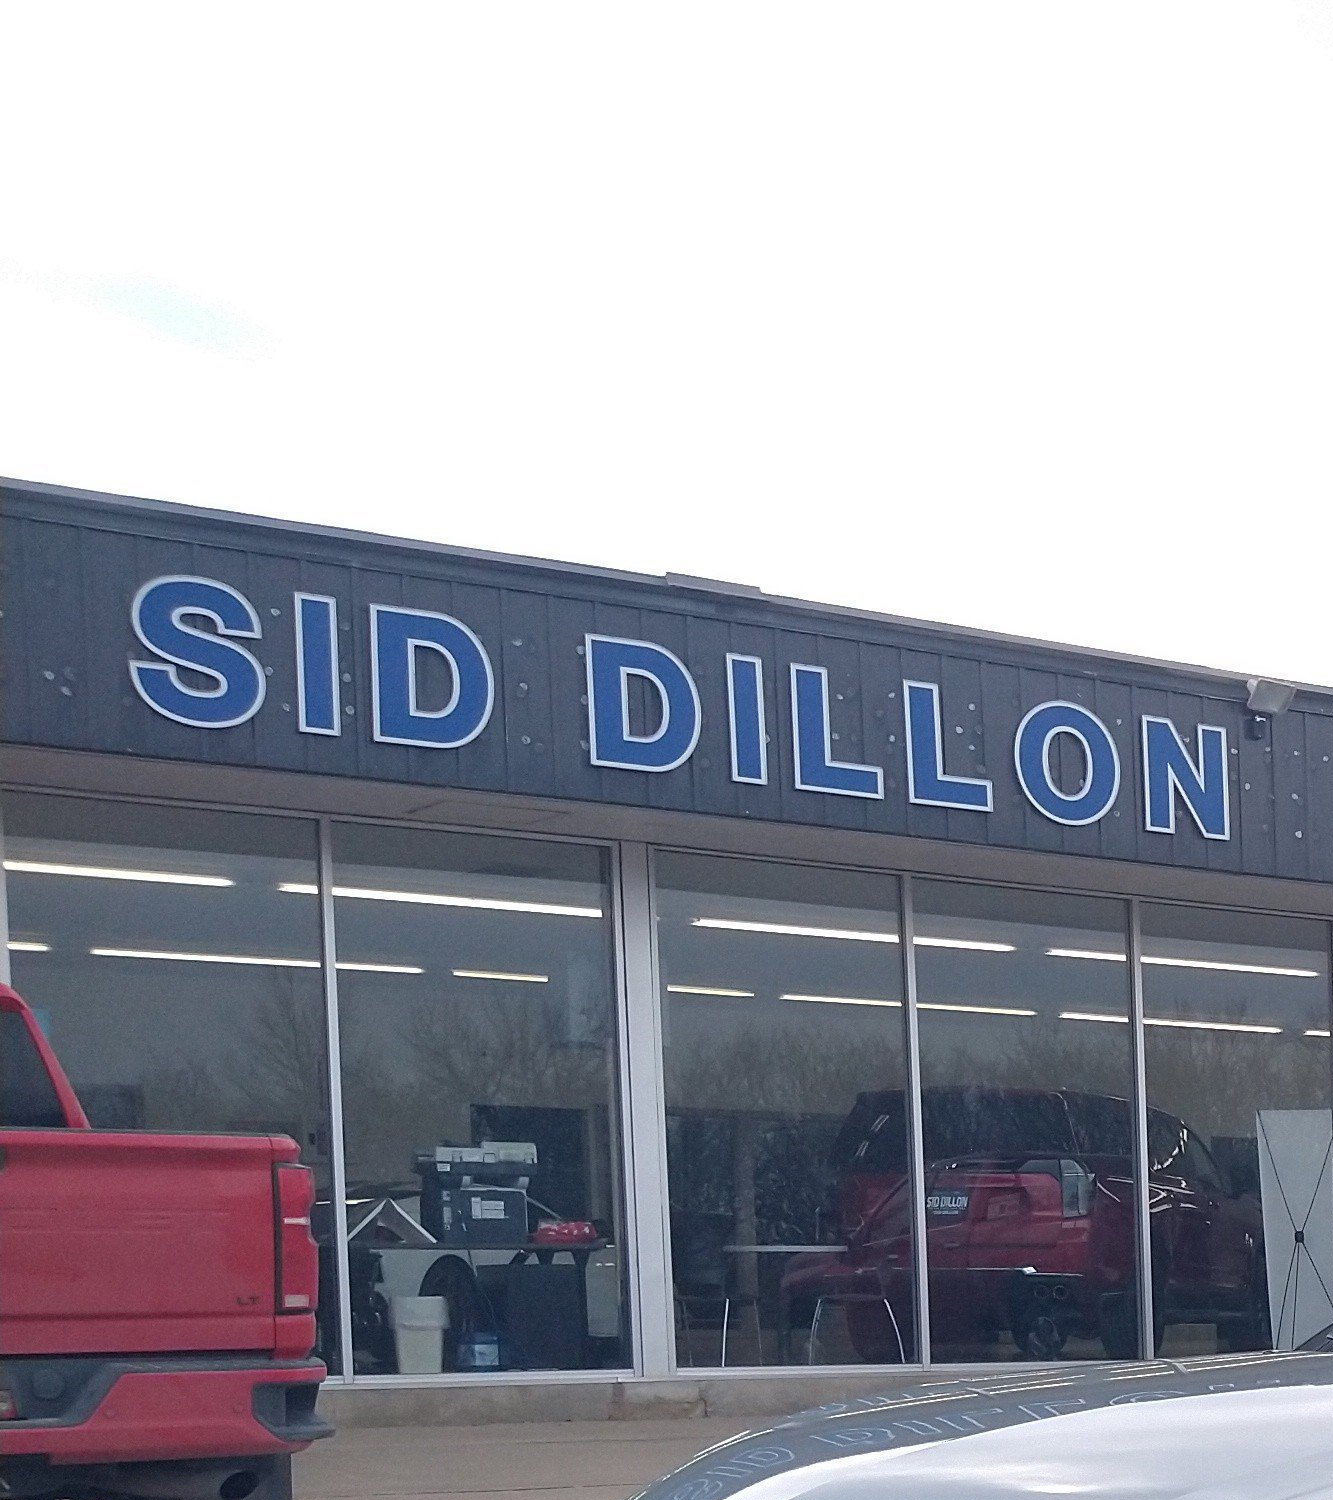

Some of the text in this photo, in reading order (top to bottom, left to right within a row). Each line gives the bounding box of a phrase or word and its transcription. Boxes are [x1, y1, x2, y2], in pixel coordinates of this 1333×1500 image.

[129, 575, 1231, 841] SID DILLON
[927, 1196, 969, 1208] SID DILLON
